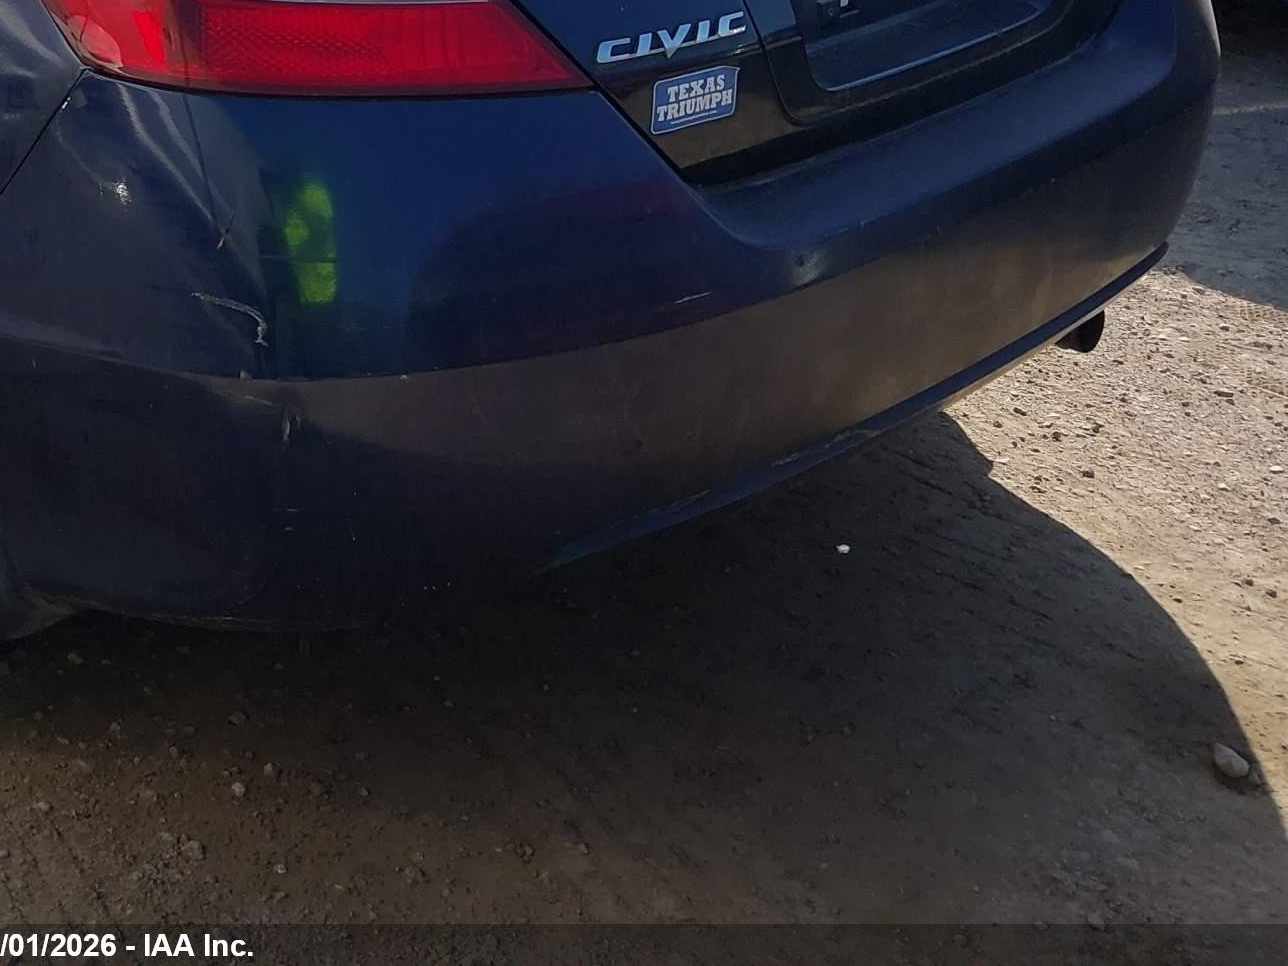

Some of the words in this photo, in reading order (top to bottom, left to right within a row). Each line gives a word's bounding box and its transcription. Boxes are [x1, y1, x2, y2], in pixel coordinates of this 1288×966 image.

[597, 11, 746, 63] CIVIC
[667, 74, 725, 103] TEXAS
[656, 89, 732, 122] TRIUMPH
